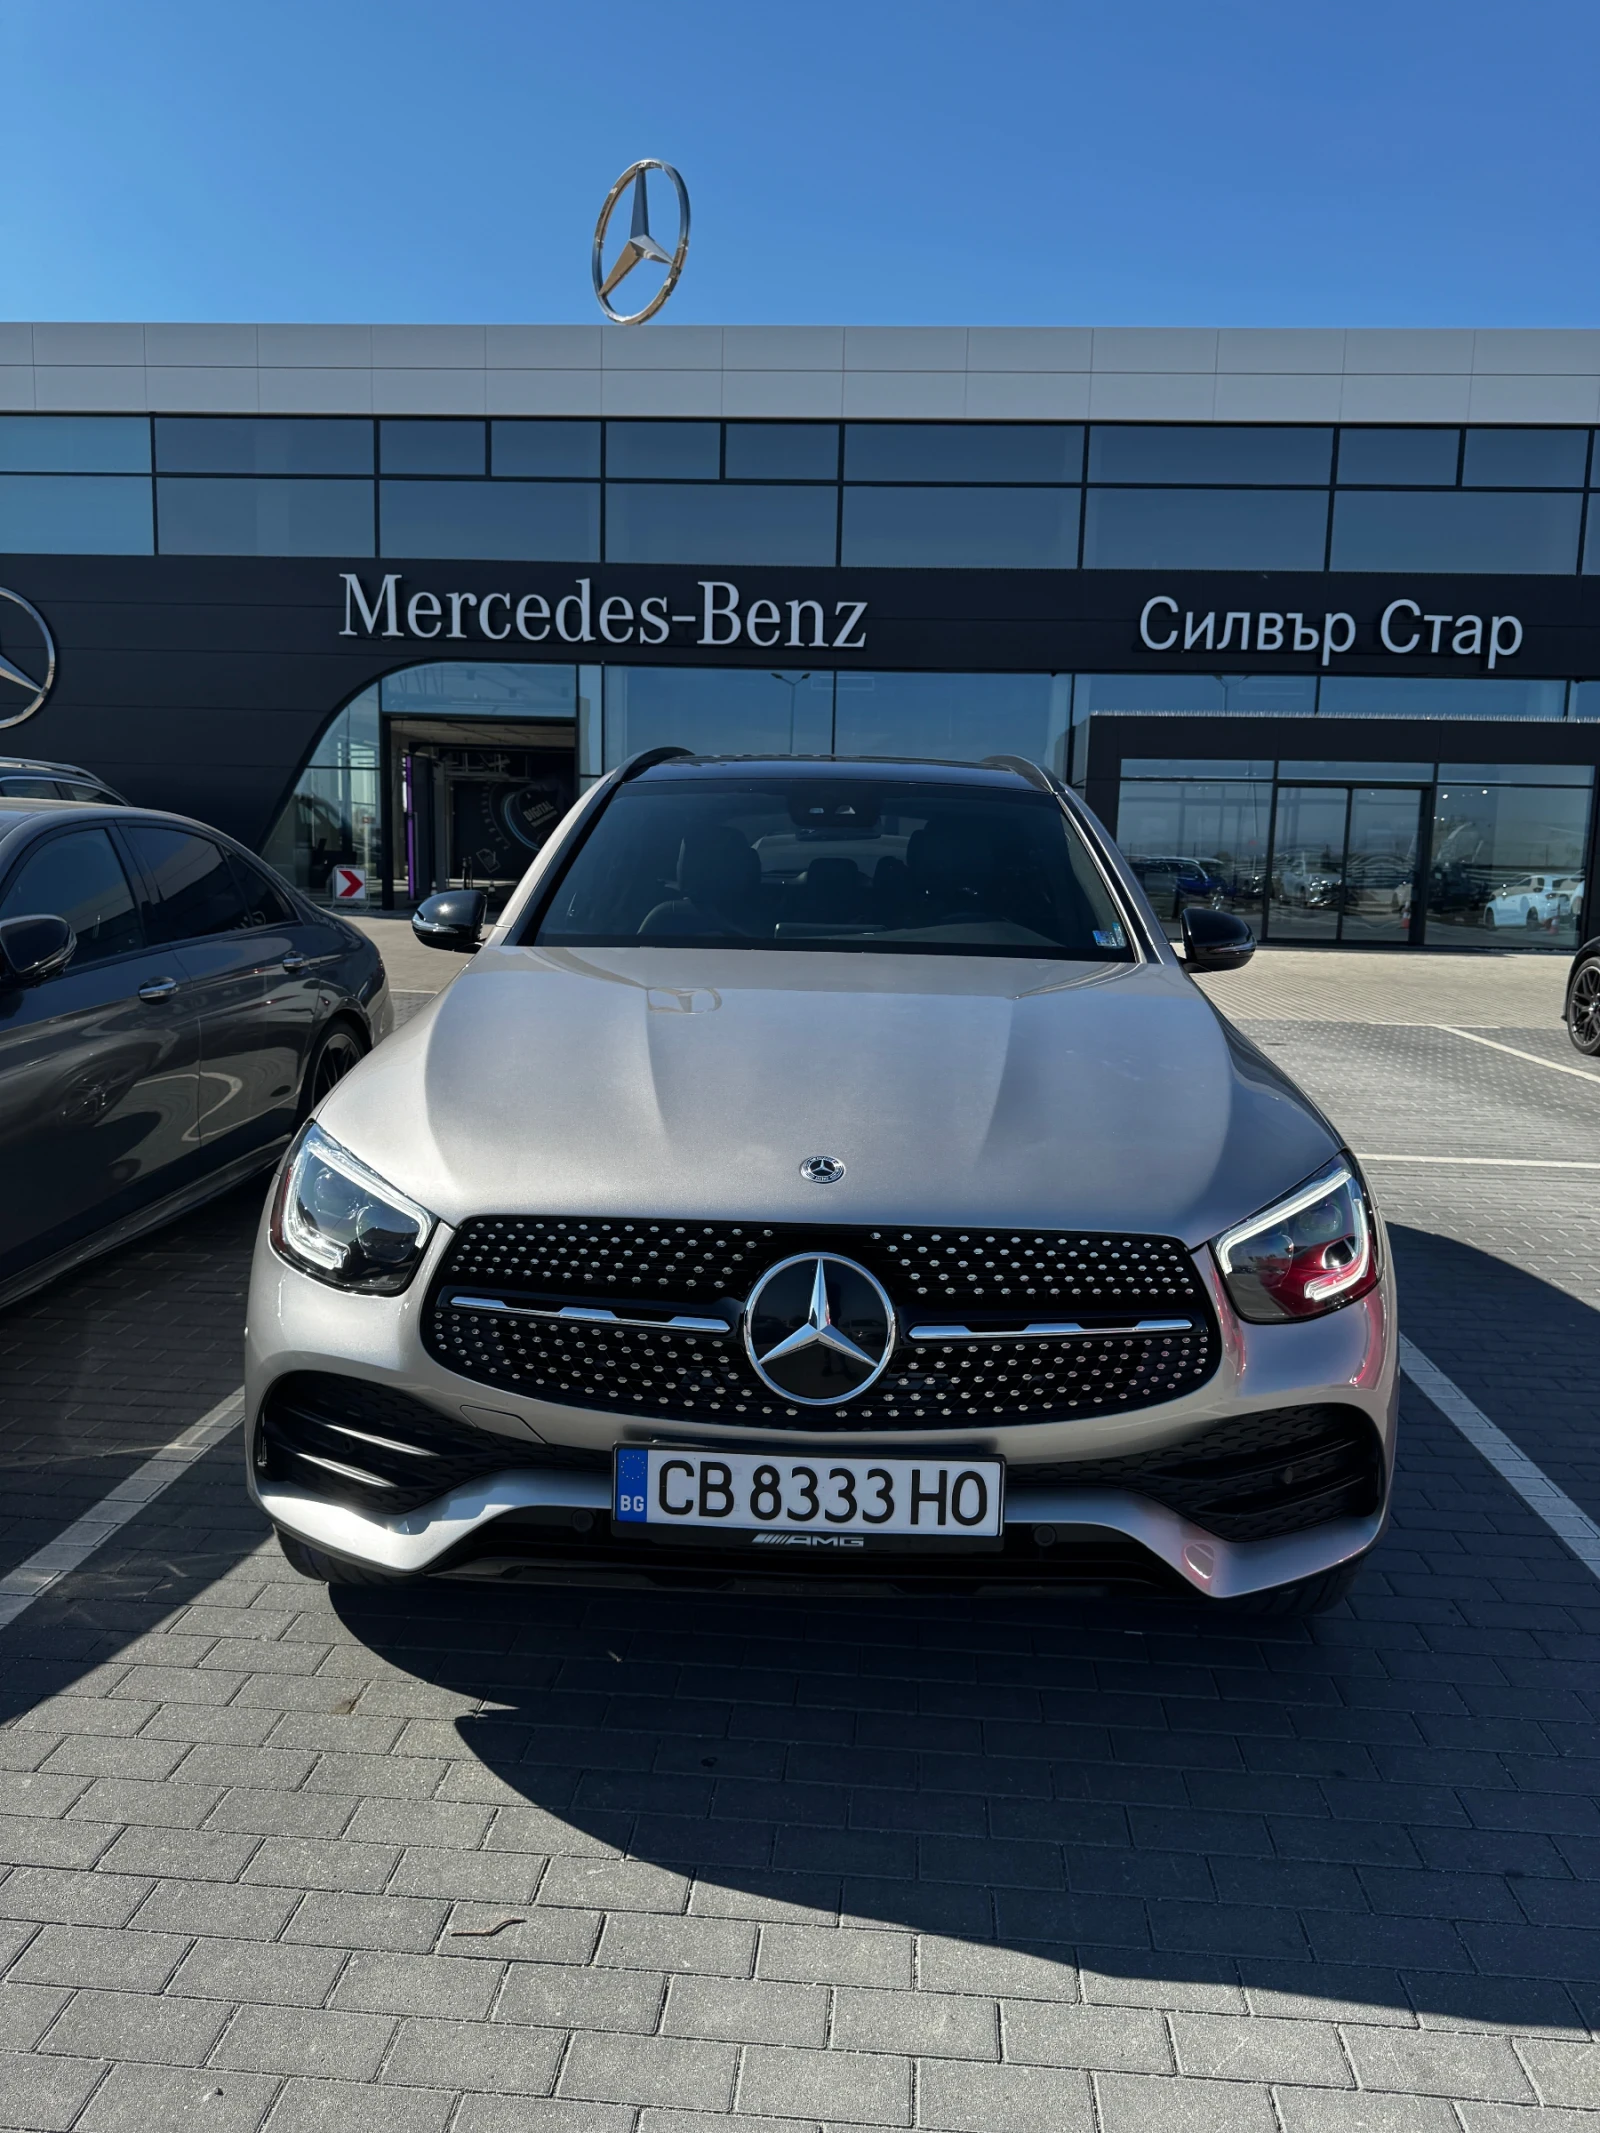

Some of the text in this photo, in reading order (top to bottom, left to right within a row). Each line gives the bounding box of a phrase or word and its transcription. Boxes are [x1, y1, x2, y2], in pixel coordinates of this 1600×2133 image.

[338, 573, 868, 648] Mercedes-Benz
[1139, 595, 1523, 669] Силвър Стар
[523, 800, 555, 822] DIGITAL
[620, 1495, 645, 1512] BG
[749, 1464, 895, 1524] 8333
